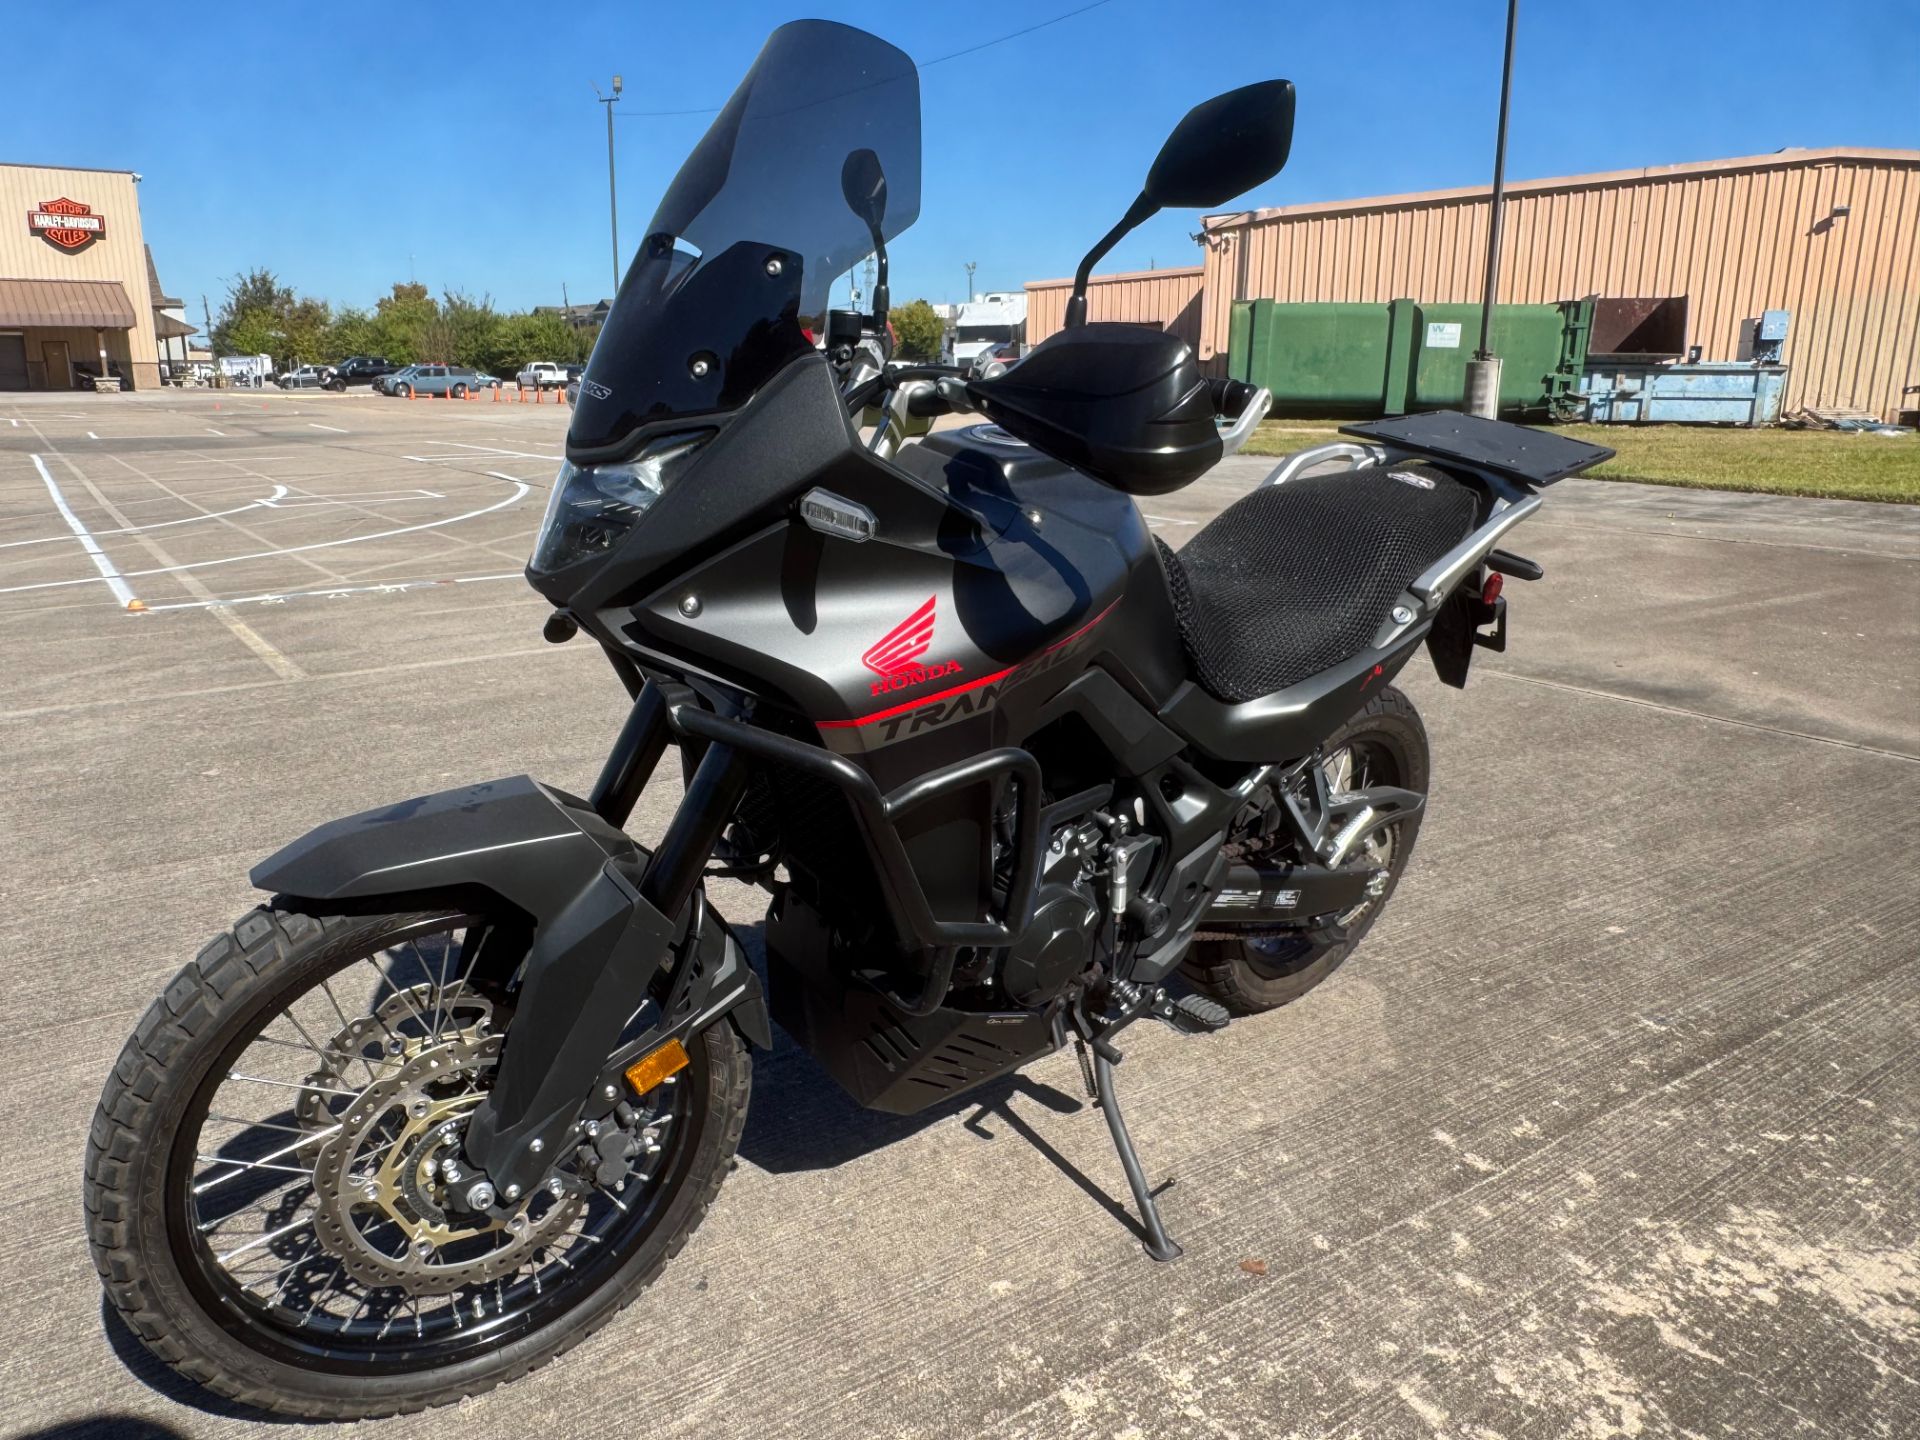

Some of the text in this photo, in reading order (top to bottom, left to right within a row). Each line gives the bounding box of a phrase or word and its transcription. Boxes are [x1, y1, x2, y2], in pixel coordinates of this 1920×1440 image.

[48, 203, 83, 214] MOTOR
[33, 214, 100, 229] HARLEY-DAVIDSON
[51, 229, 86, 243] CYCLES
[870, 660, 964, 697] HONDA
